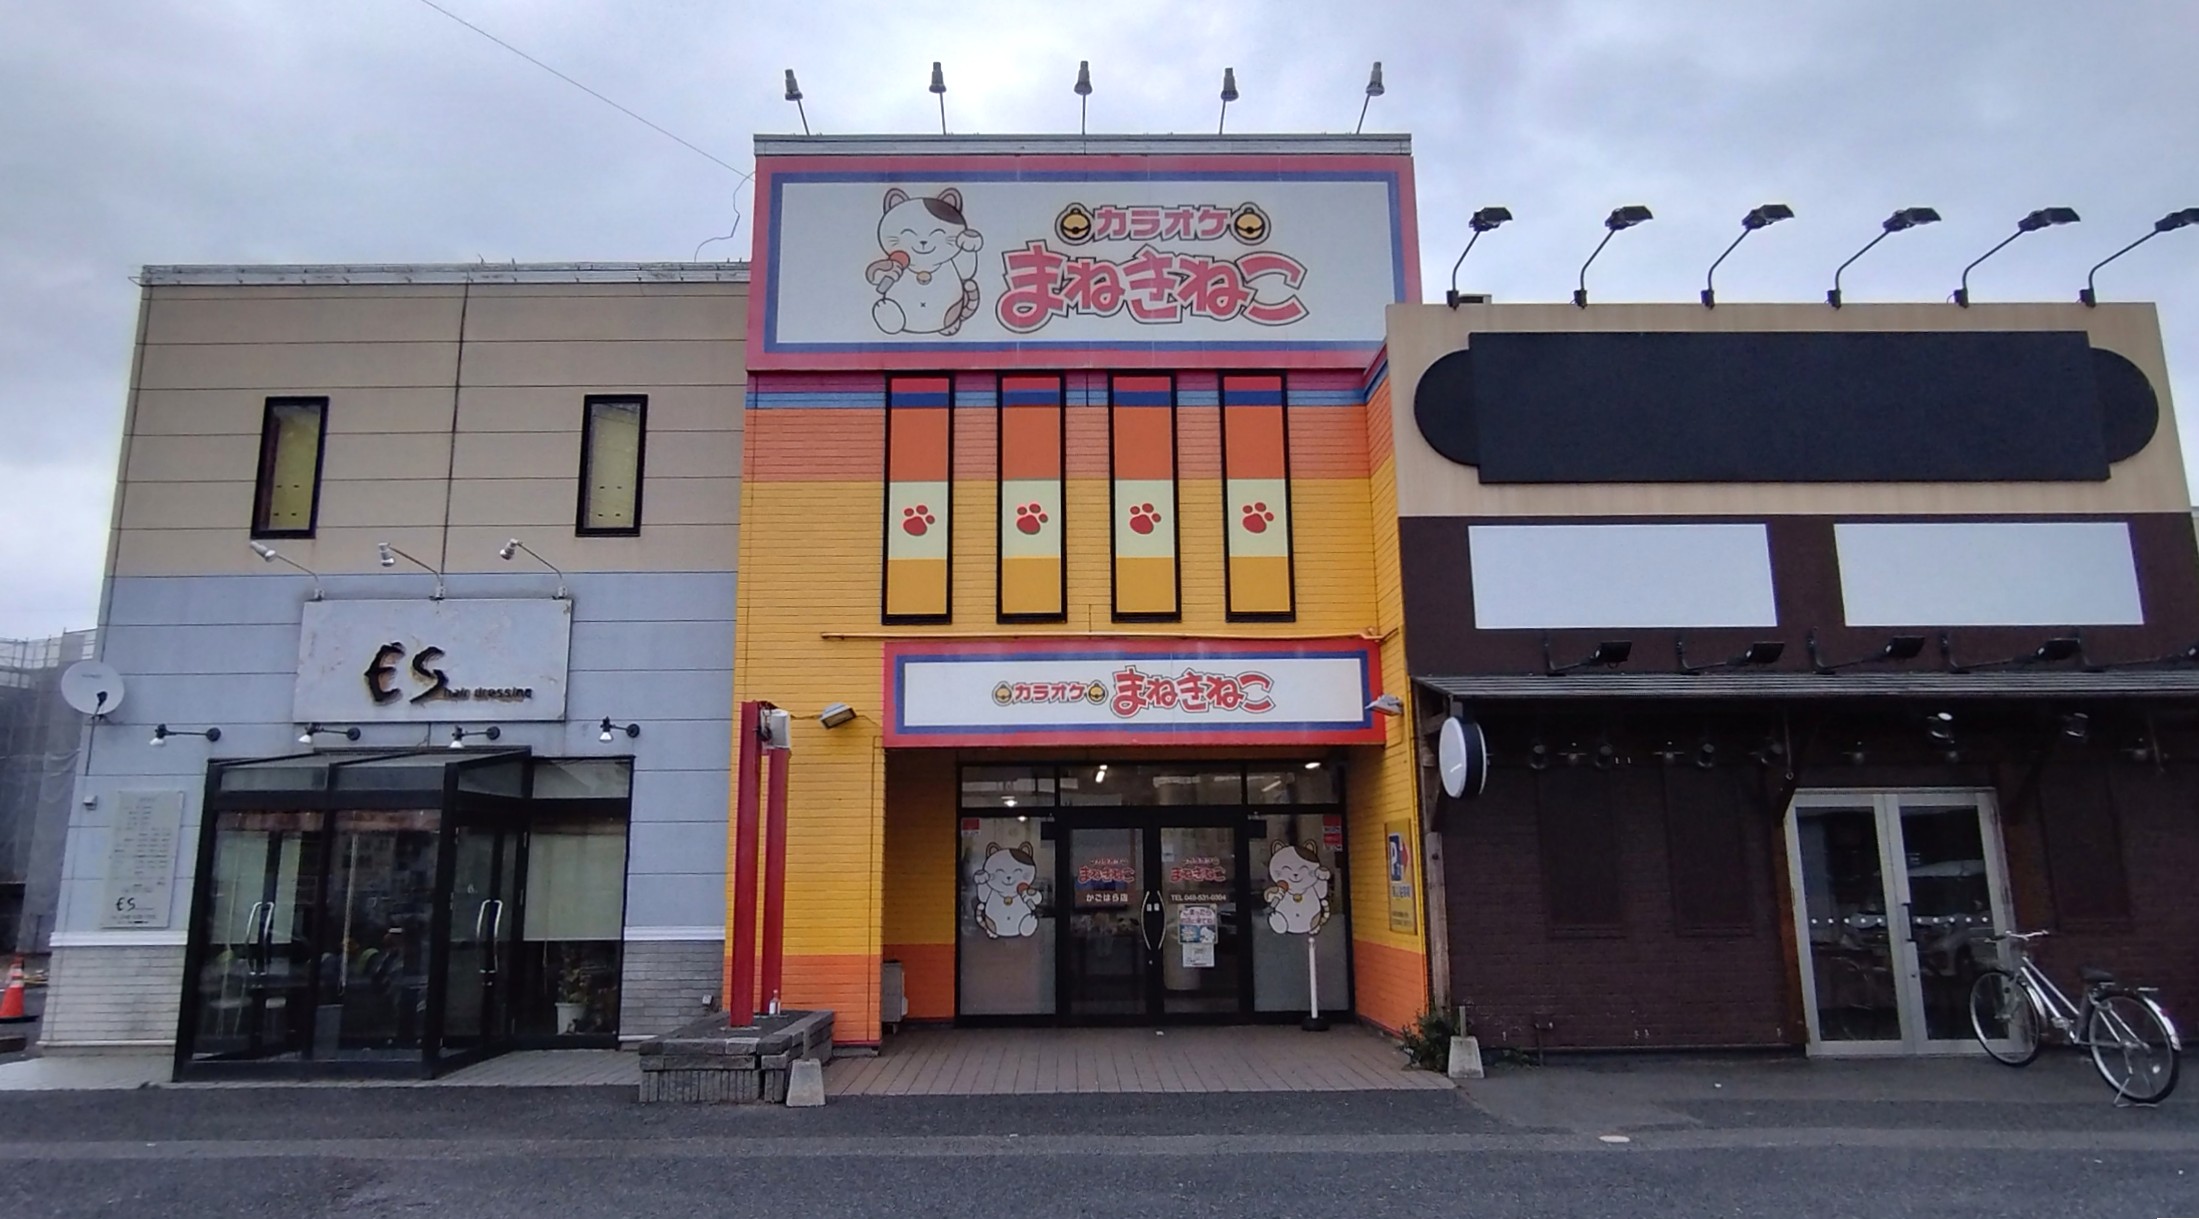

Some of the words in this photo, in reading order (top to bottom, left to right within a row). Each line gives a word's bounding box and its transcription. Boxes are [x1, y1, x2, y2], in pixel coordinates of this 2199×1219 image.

[1095, 205, 1231, 240] カラオケ
[997, 241, 1307, 332] まねきねこ
[443, 687, 470, 700] hair
[1013, 681, 1087, 702] カラオケ
[1111, 666, 1275, 718] まねきねこ
